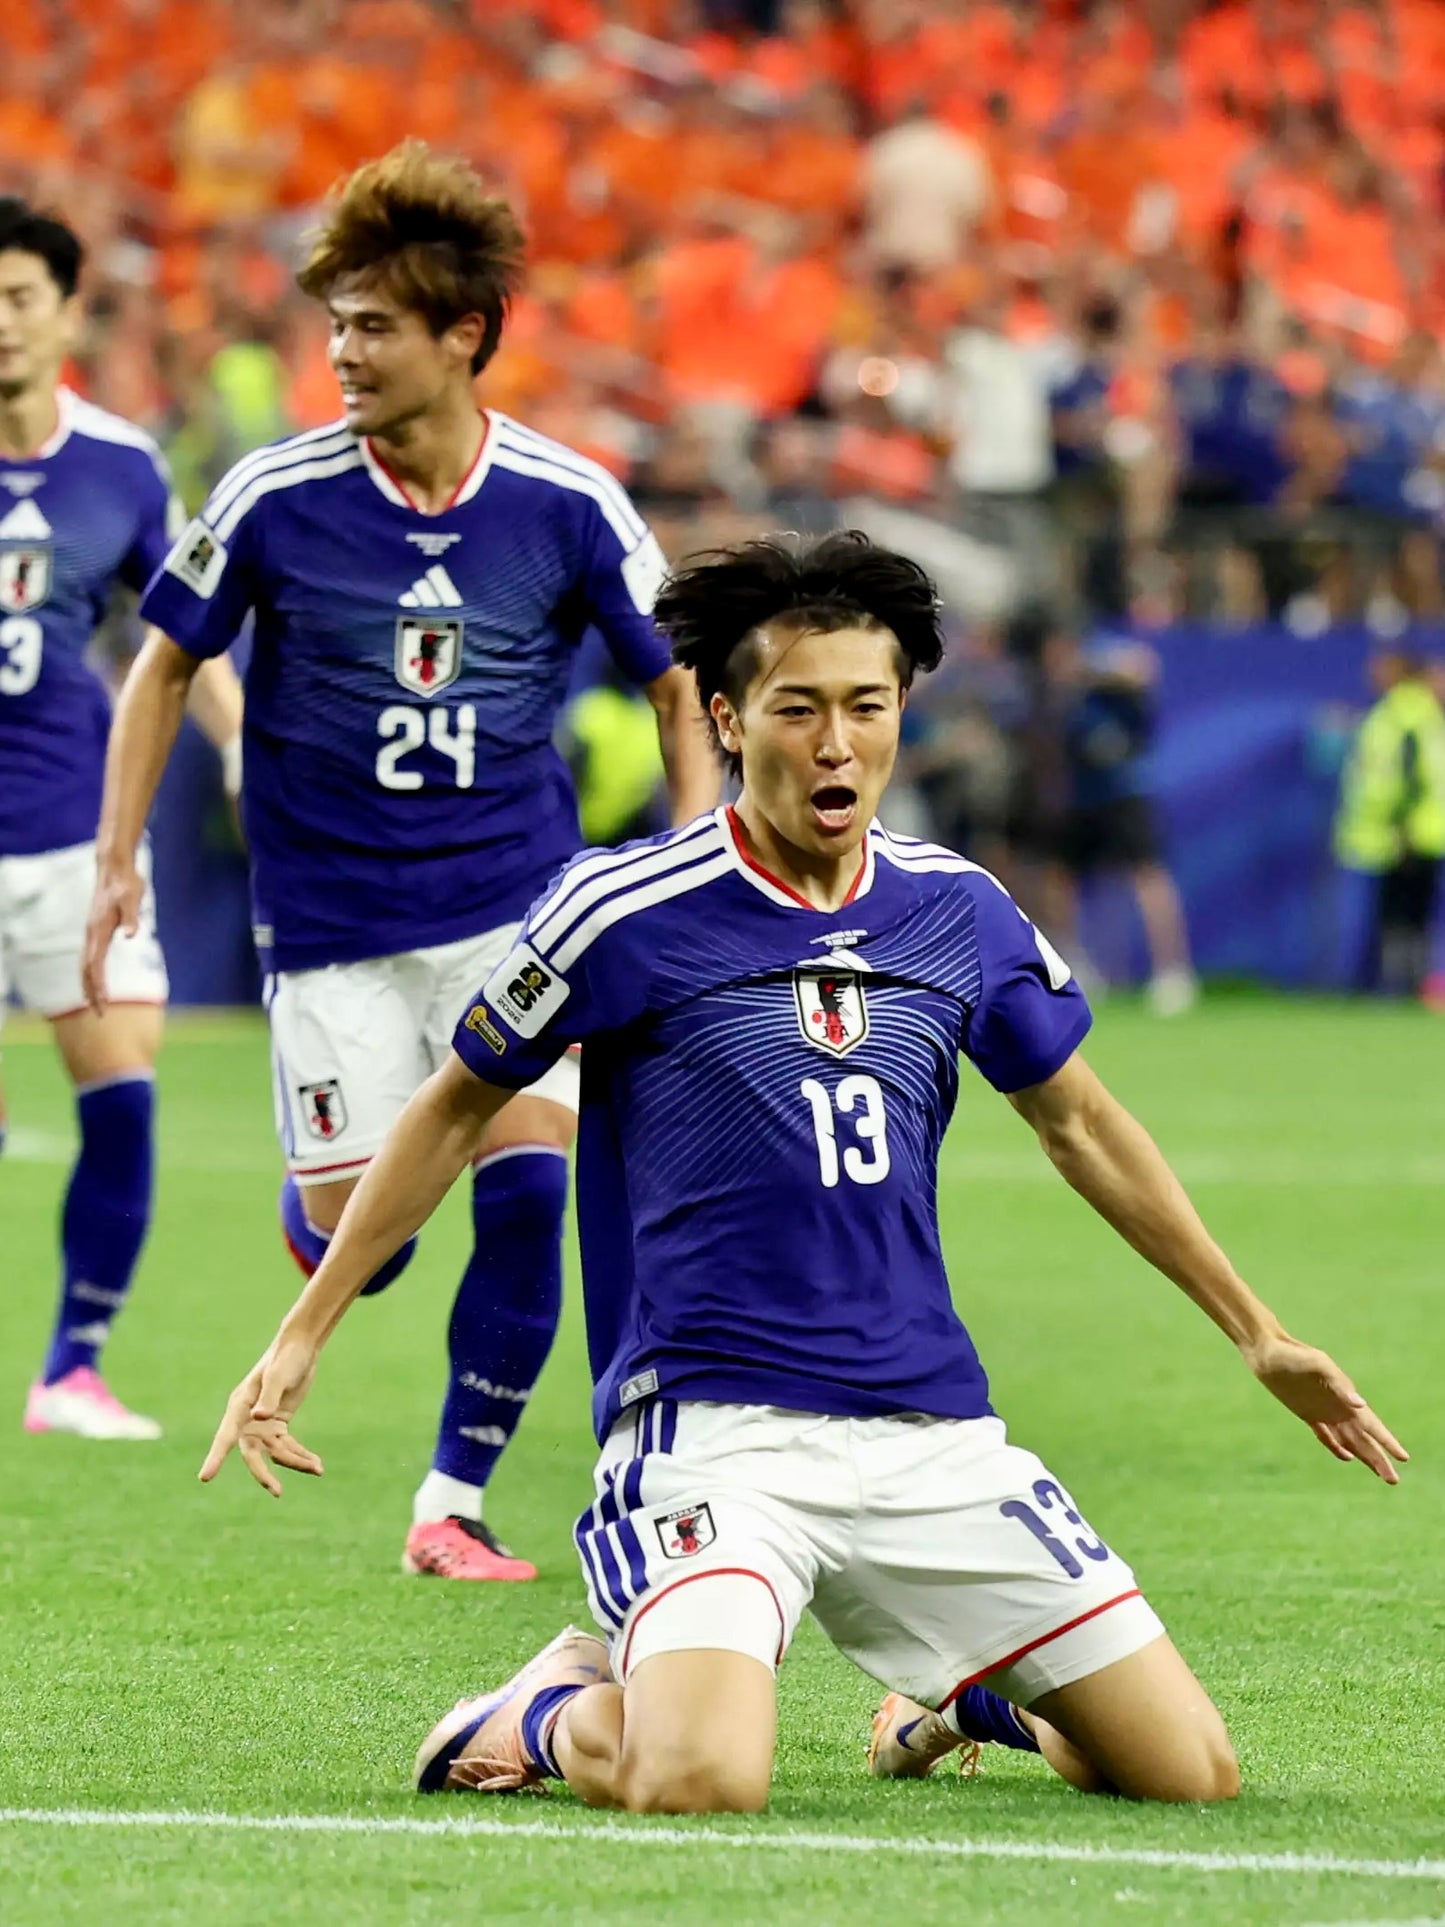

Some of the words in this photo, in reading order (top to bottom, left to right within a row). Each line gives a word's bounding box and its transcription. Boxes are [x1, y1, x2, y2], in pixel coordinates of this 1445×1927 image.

[0, 616, 43, 696] 3
[375, 703, 477, 790] 24
[496, 997, 522, 1025] 2026
[800, 1073, 891, 1188] 13
[999, 1479, 1109, 1579] 13
